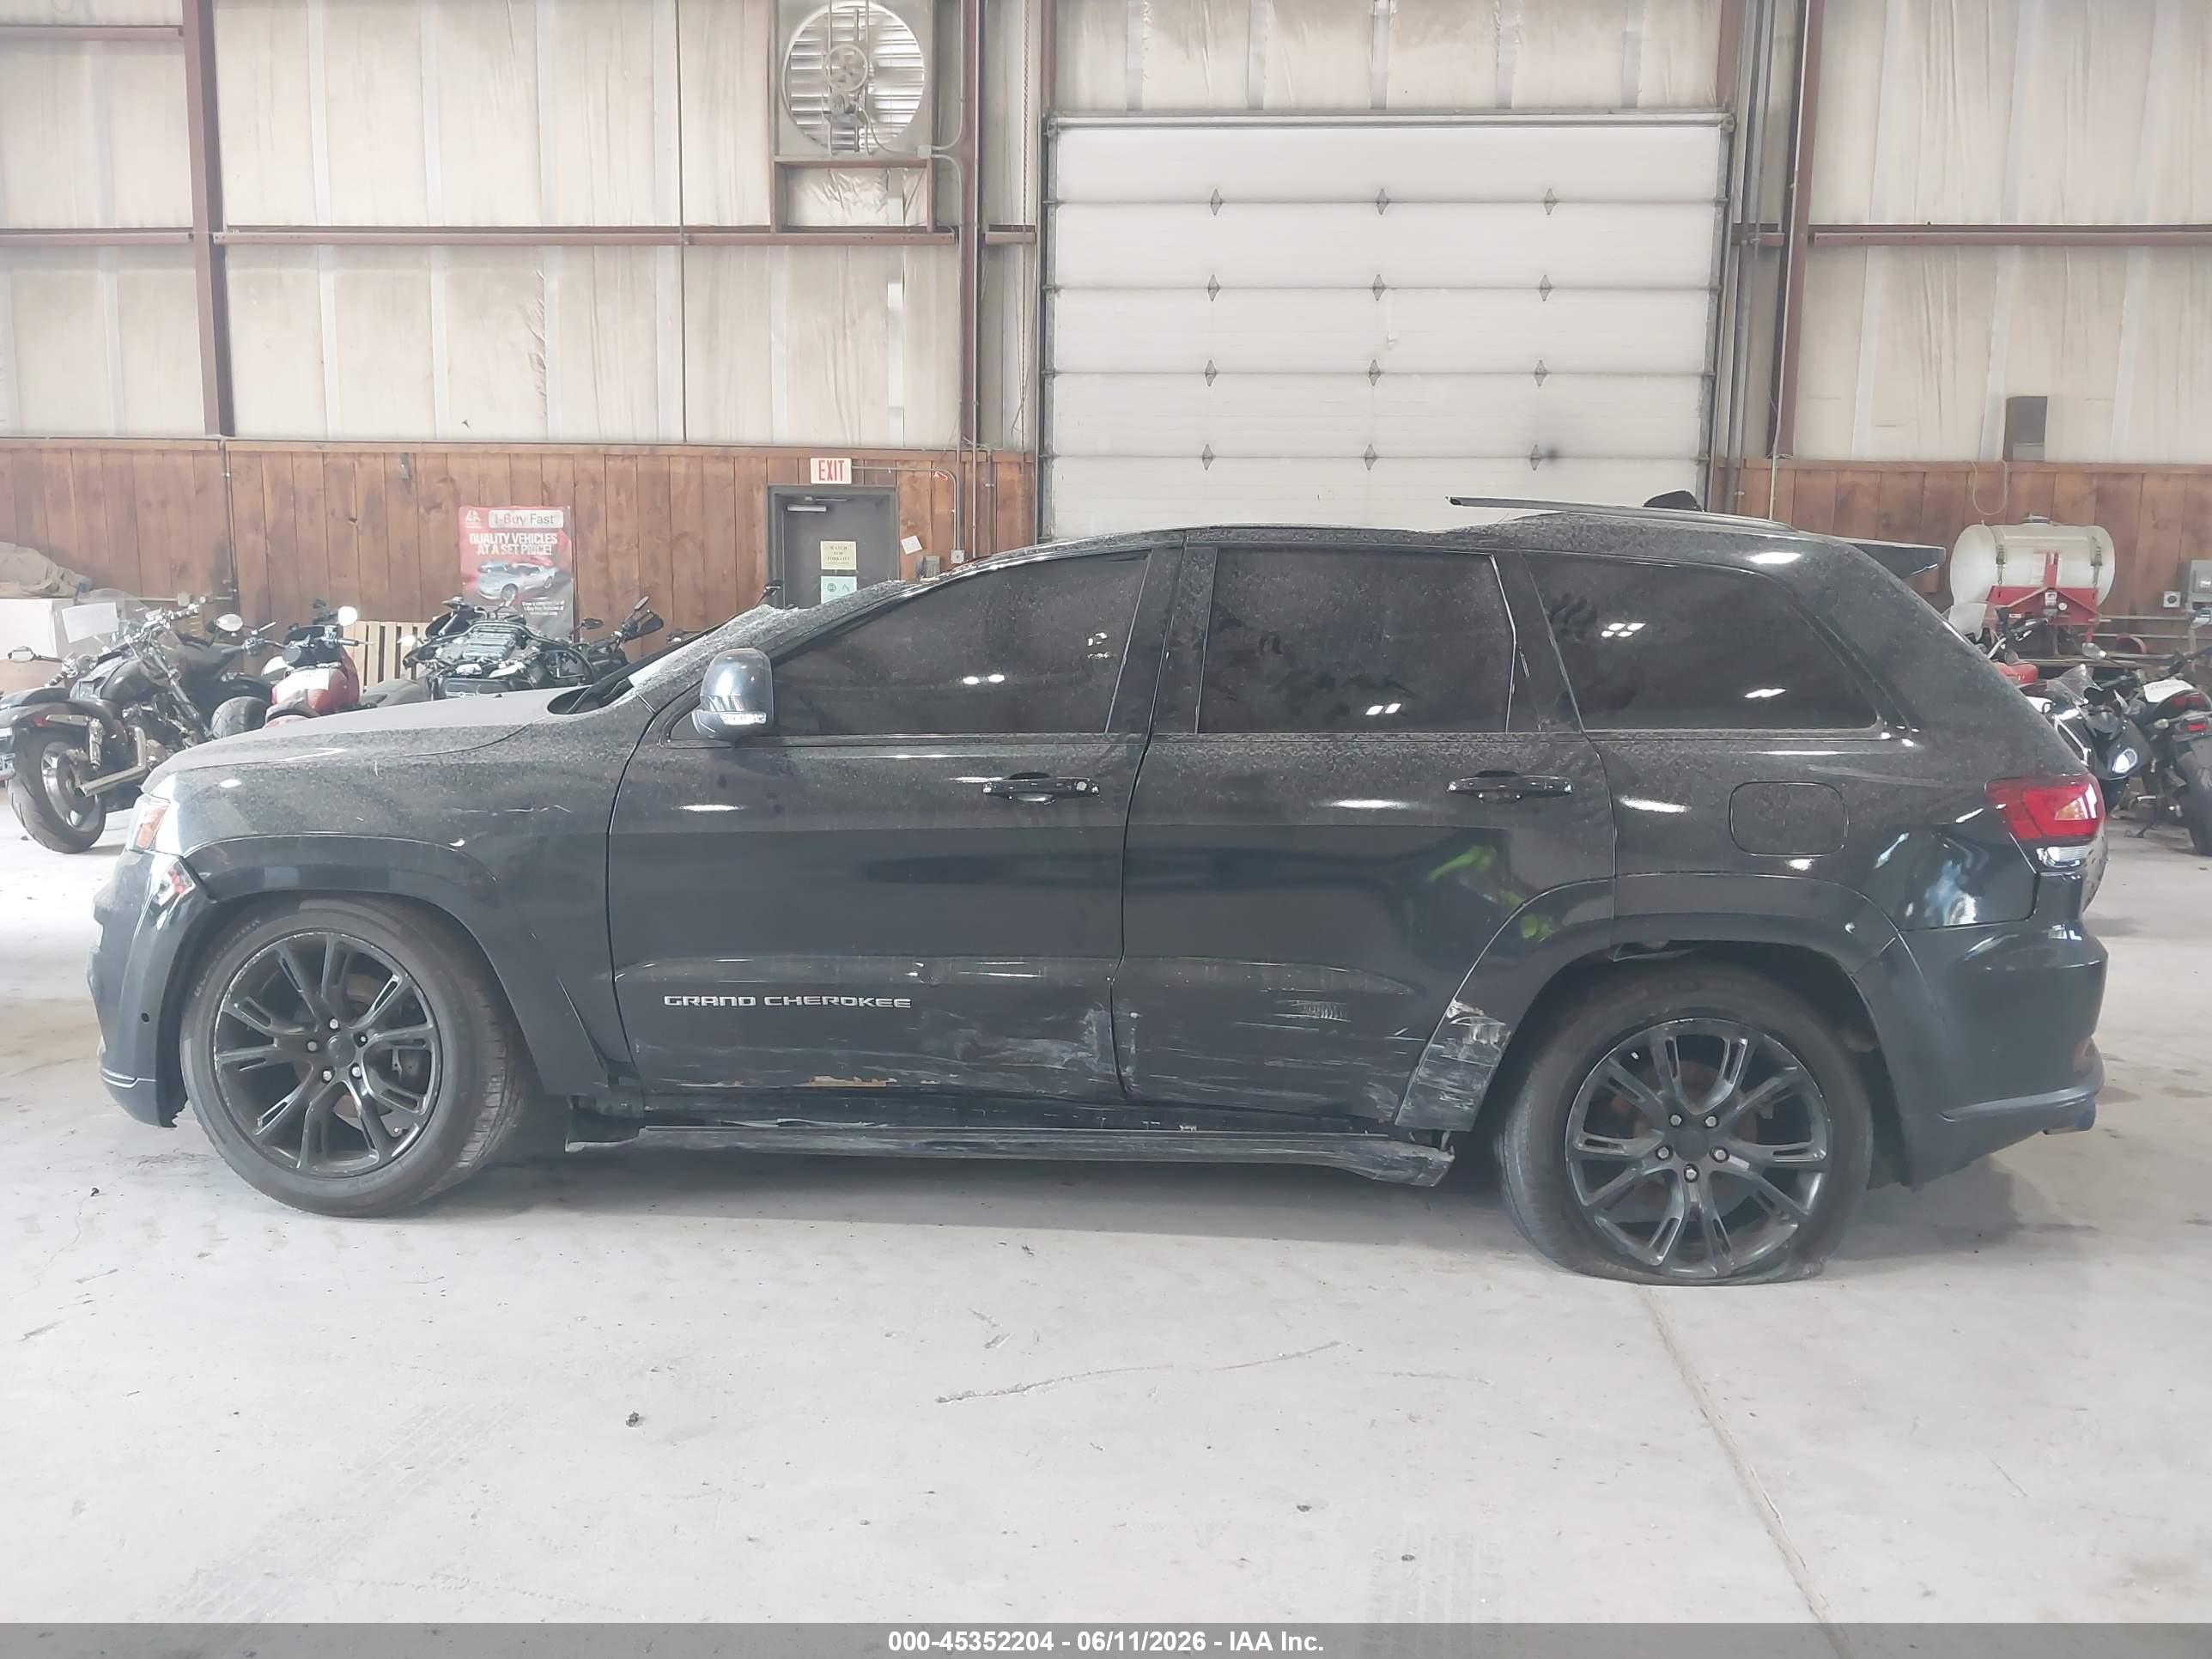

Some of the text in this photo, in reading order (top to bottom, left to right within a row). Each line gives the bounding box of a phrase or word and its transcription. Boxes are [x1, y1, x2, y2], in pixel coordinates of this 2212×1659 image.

[818, 459, 844, 481] EXIT
[495, 514, 555, 525] I-Buy Fast
[470, 532, 558, 544] QUALITY VEHICLES
[477, 544, 491, 556] AT
[491, 544, 500, 556] A
[501, 544, 520, 556] SET
[664, 995, 911, 1008] GRAND CHEROKEE
